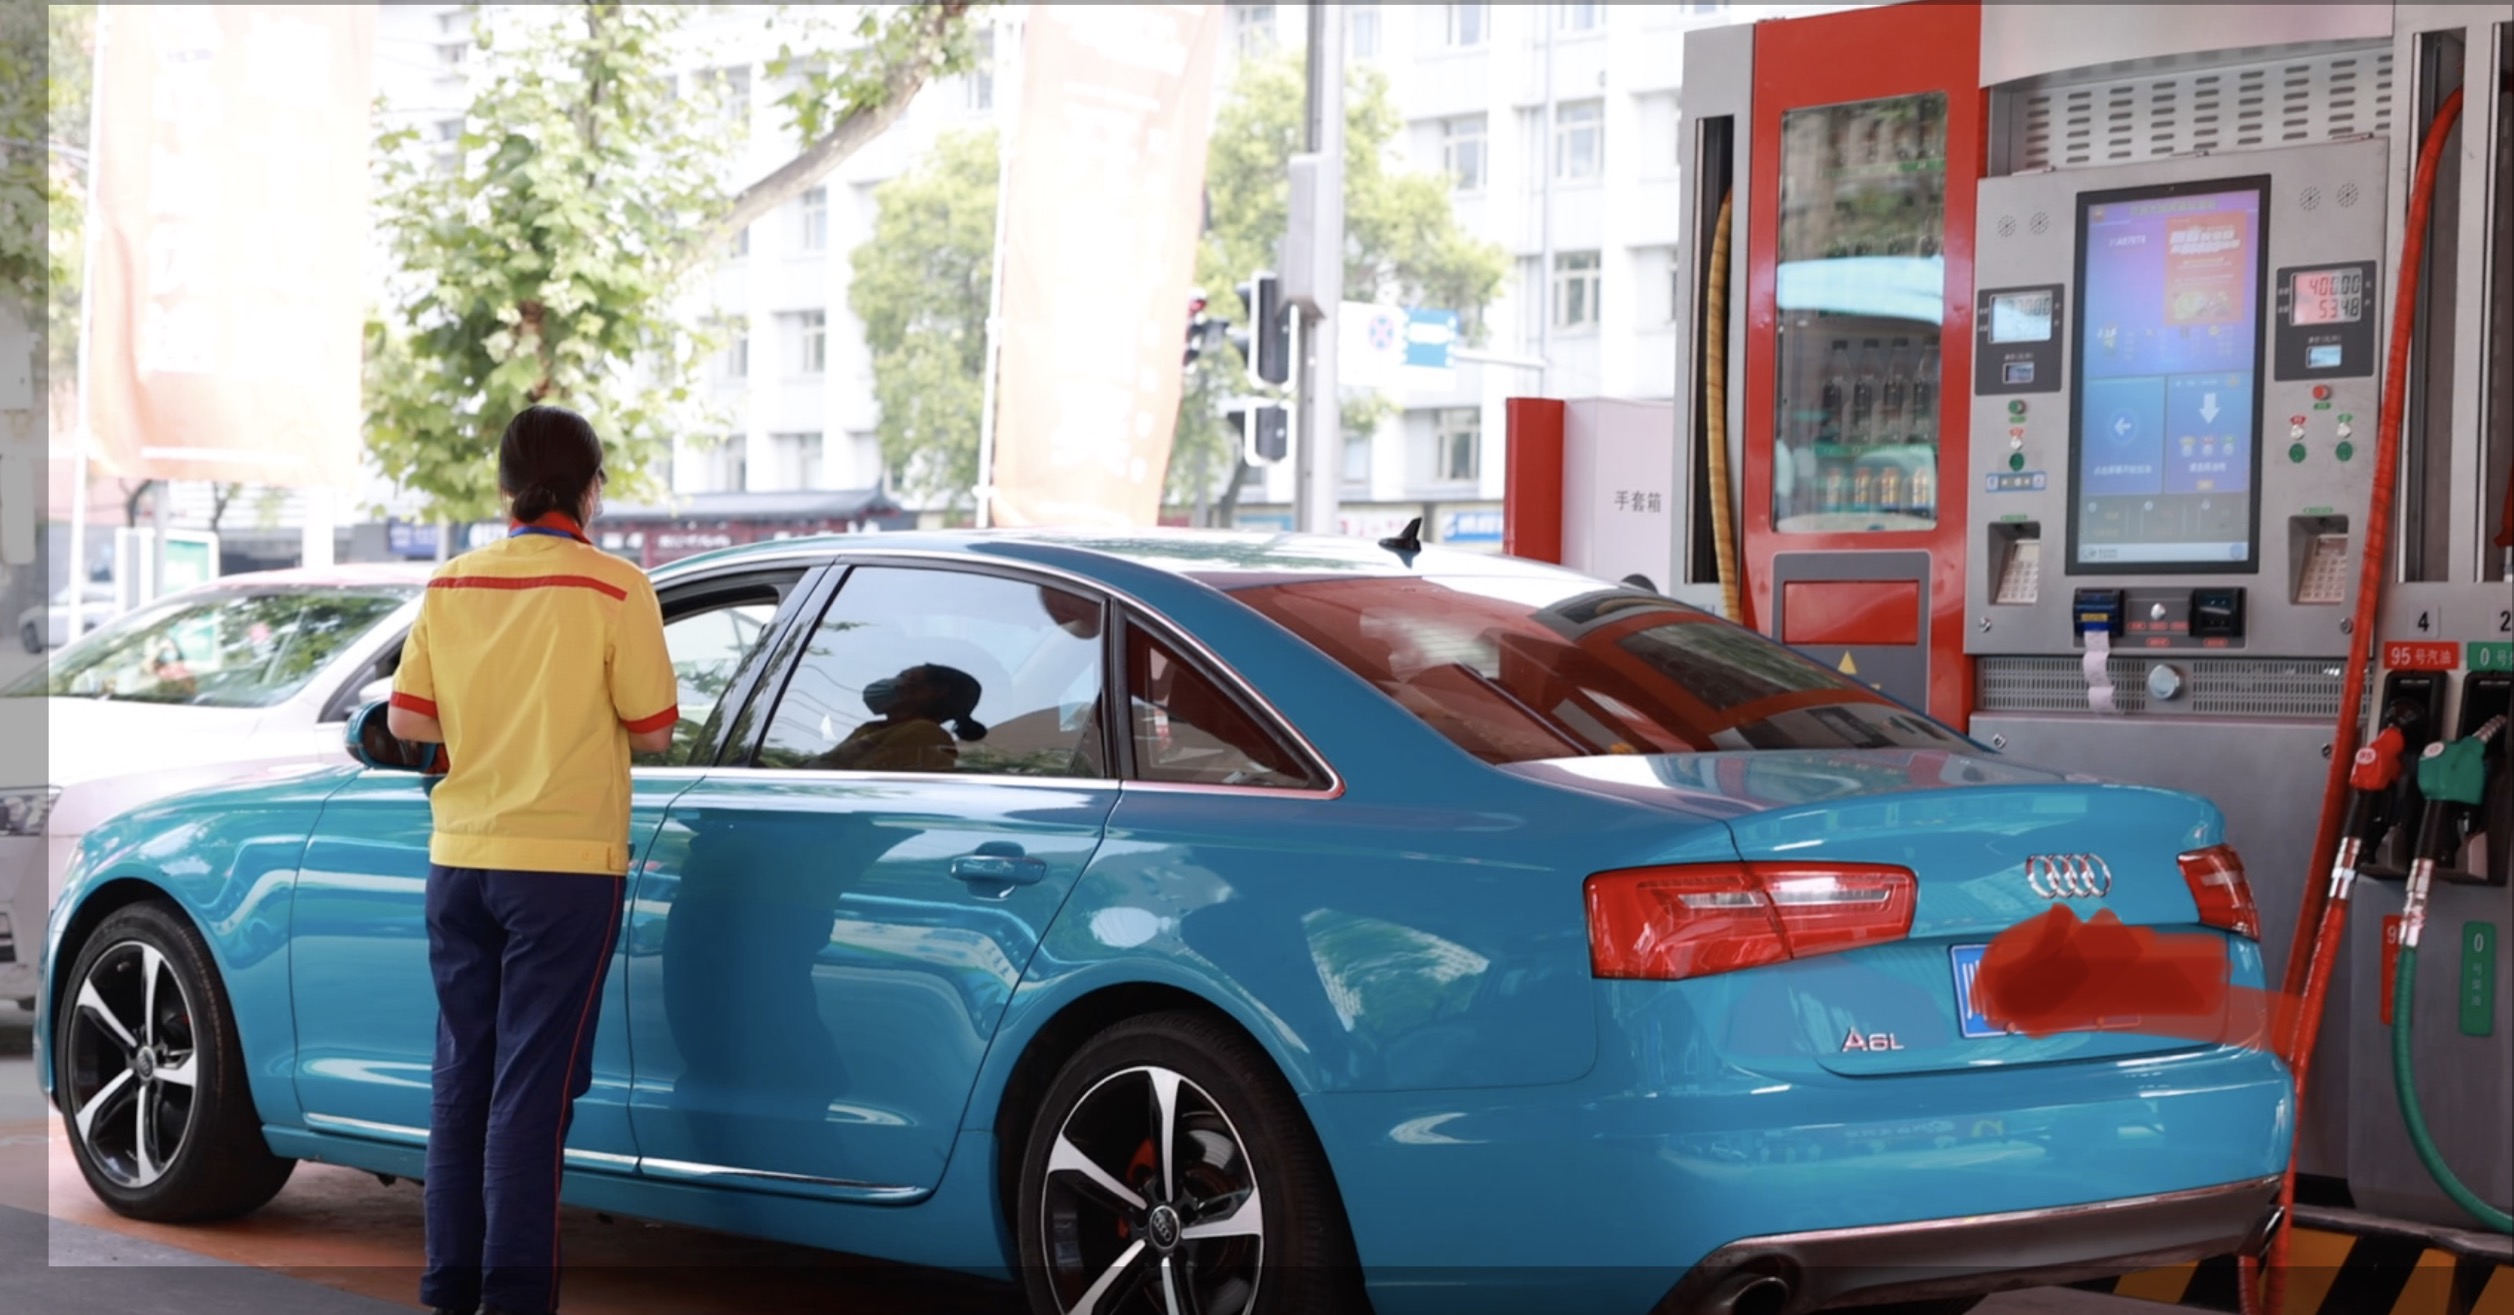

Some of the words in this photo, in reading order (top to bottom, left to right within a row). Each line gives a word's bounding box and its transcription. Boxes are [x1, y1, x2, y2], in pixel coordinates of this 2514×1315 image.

[1615, 491, 1661, 513] 手套箱
[2418, 611, 2429, 632] 4
[2500, 610, 2511, 632] 2
[1842, 1027, 1904, 1053] A6L
